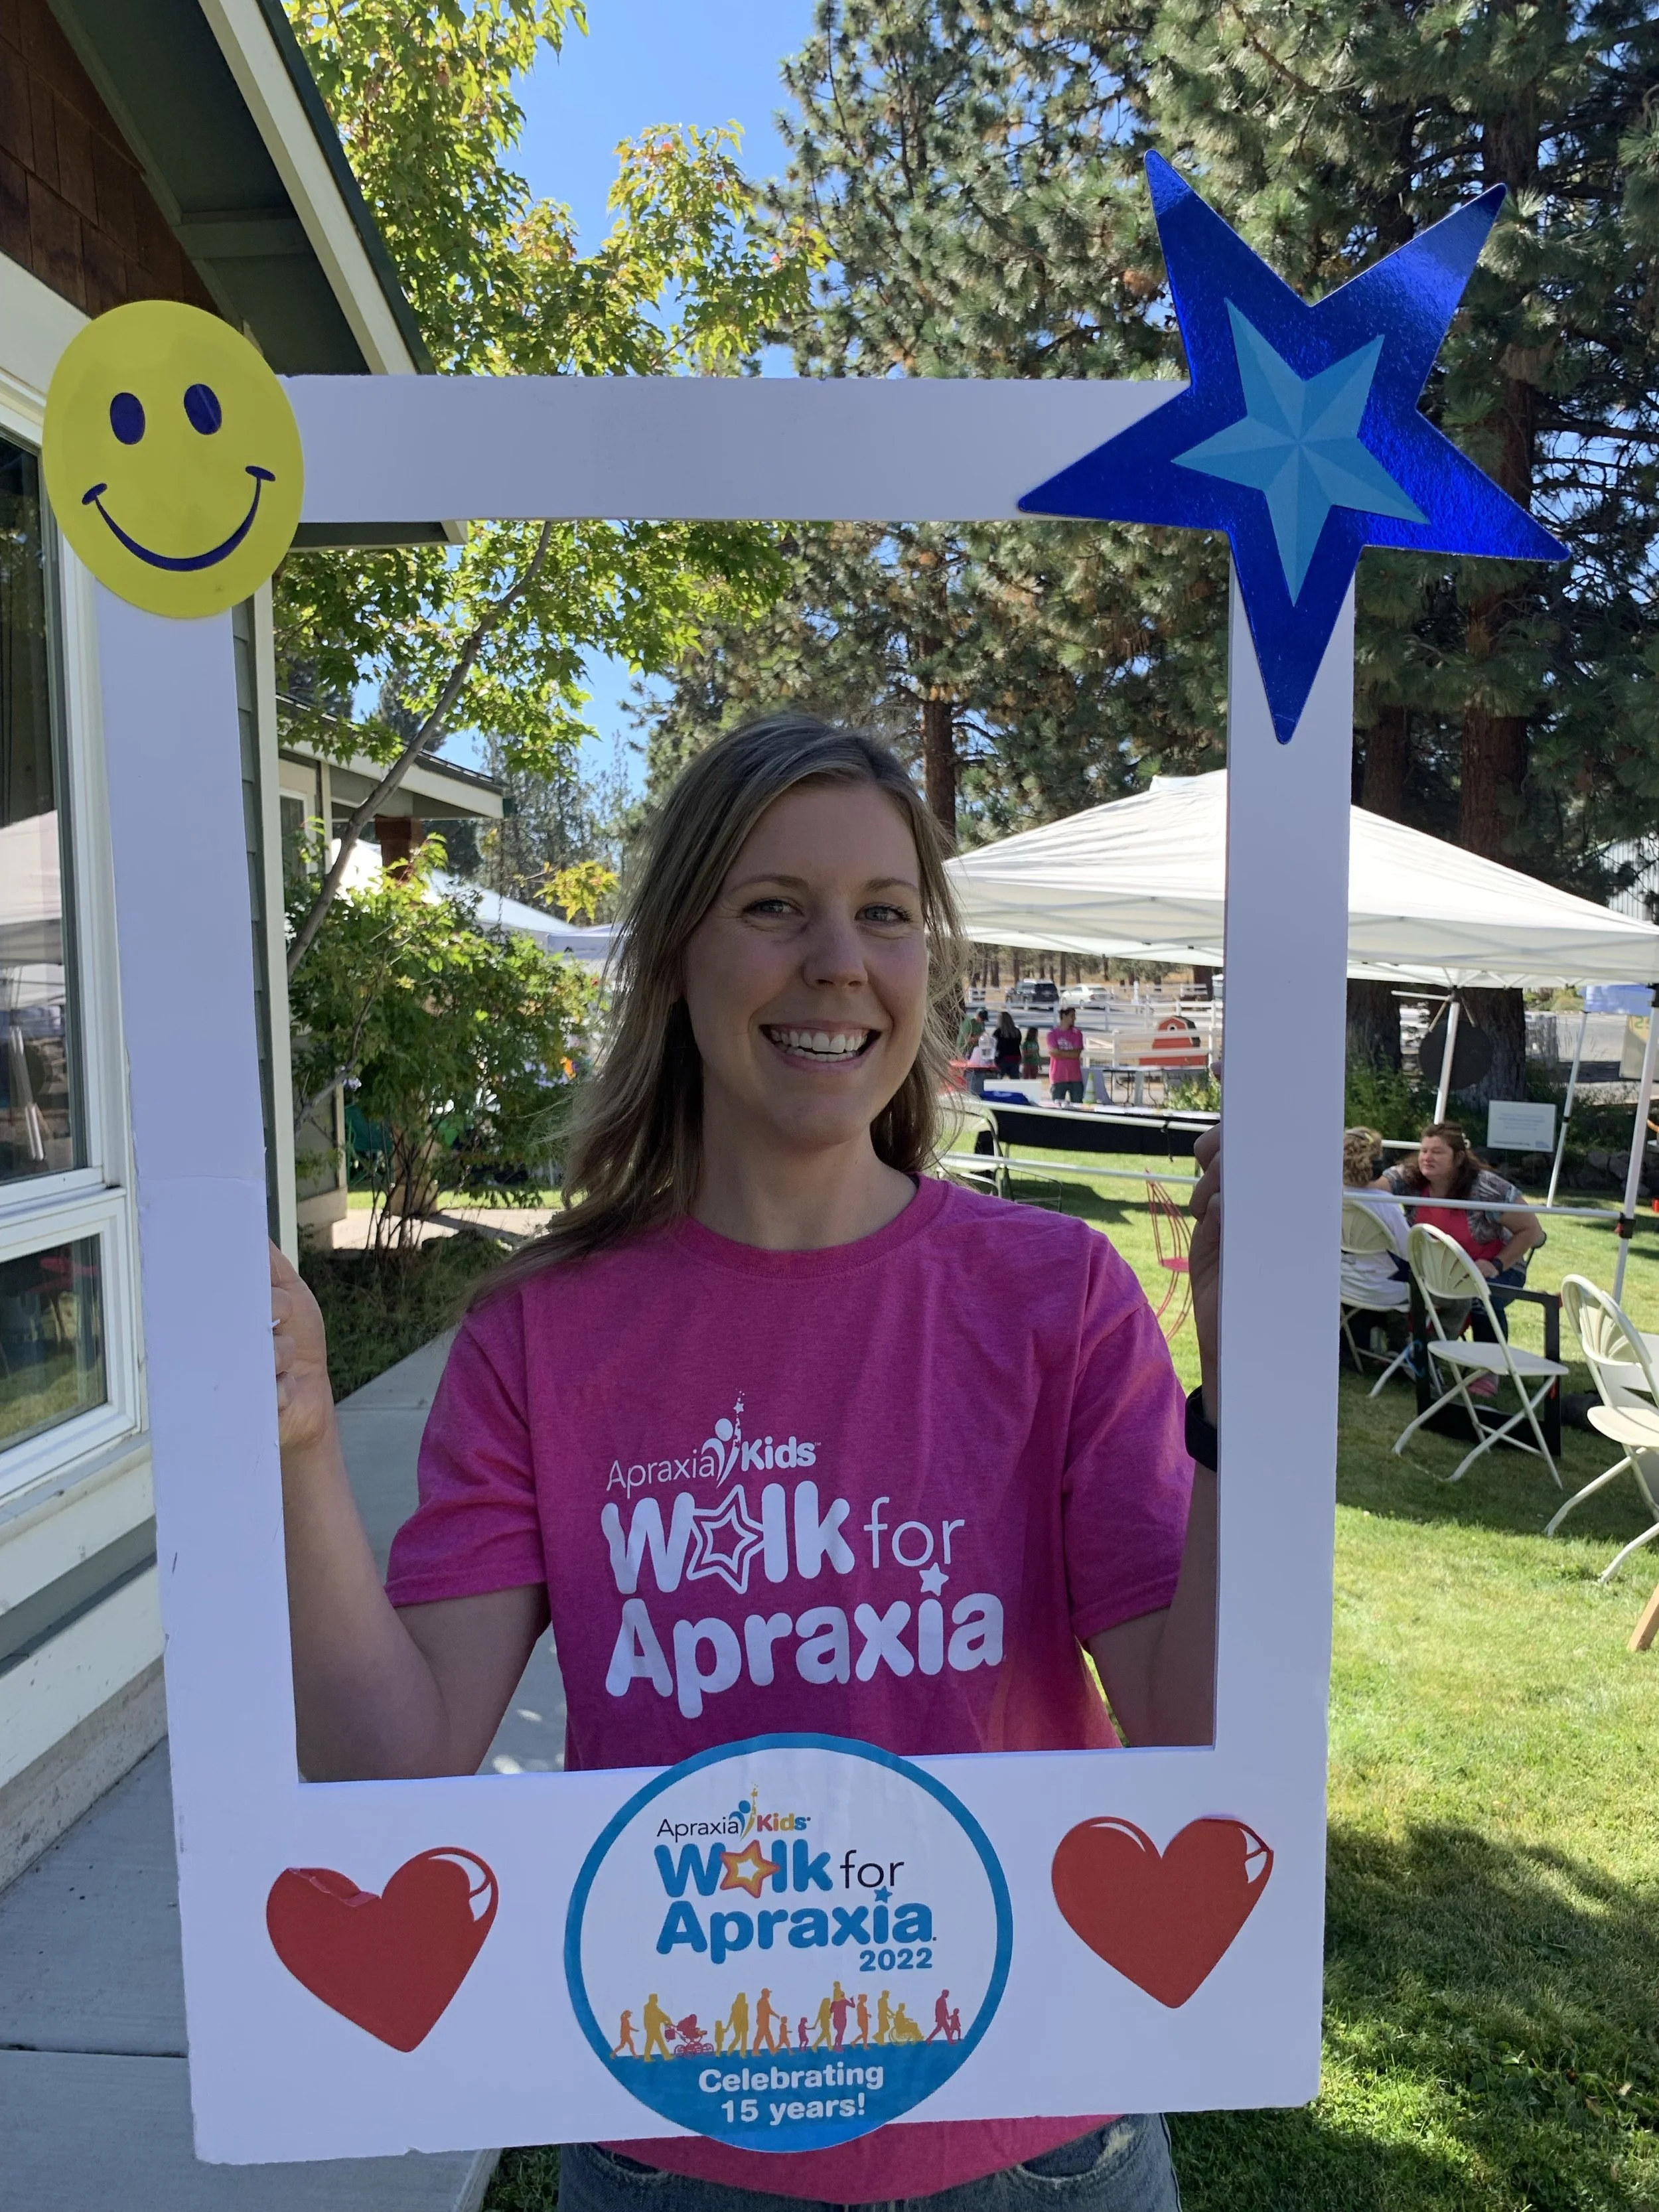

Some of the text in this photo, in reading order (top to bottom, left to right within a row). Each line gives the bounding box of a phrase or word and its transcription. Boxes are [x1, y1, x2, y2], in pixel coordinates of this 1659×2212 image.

[607, 1449, 715, 1499] Apraxia
[864, 1497, 965, 1568] for
[605, 1563, 1004, 1719] Apraxia
[656, 1816, 739, 1843] Apraxia
[839, 1850, 904, 1889] for
[859, 1947, 933, 1972] 2022
[699, 2061, 884, 2093] Celebrating
[721, 2093, 865, 2126] 15 years!
